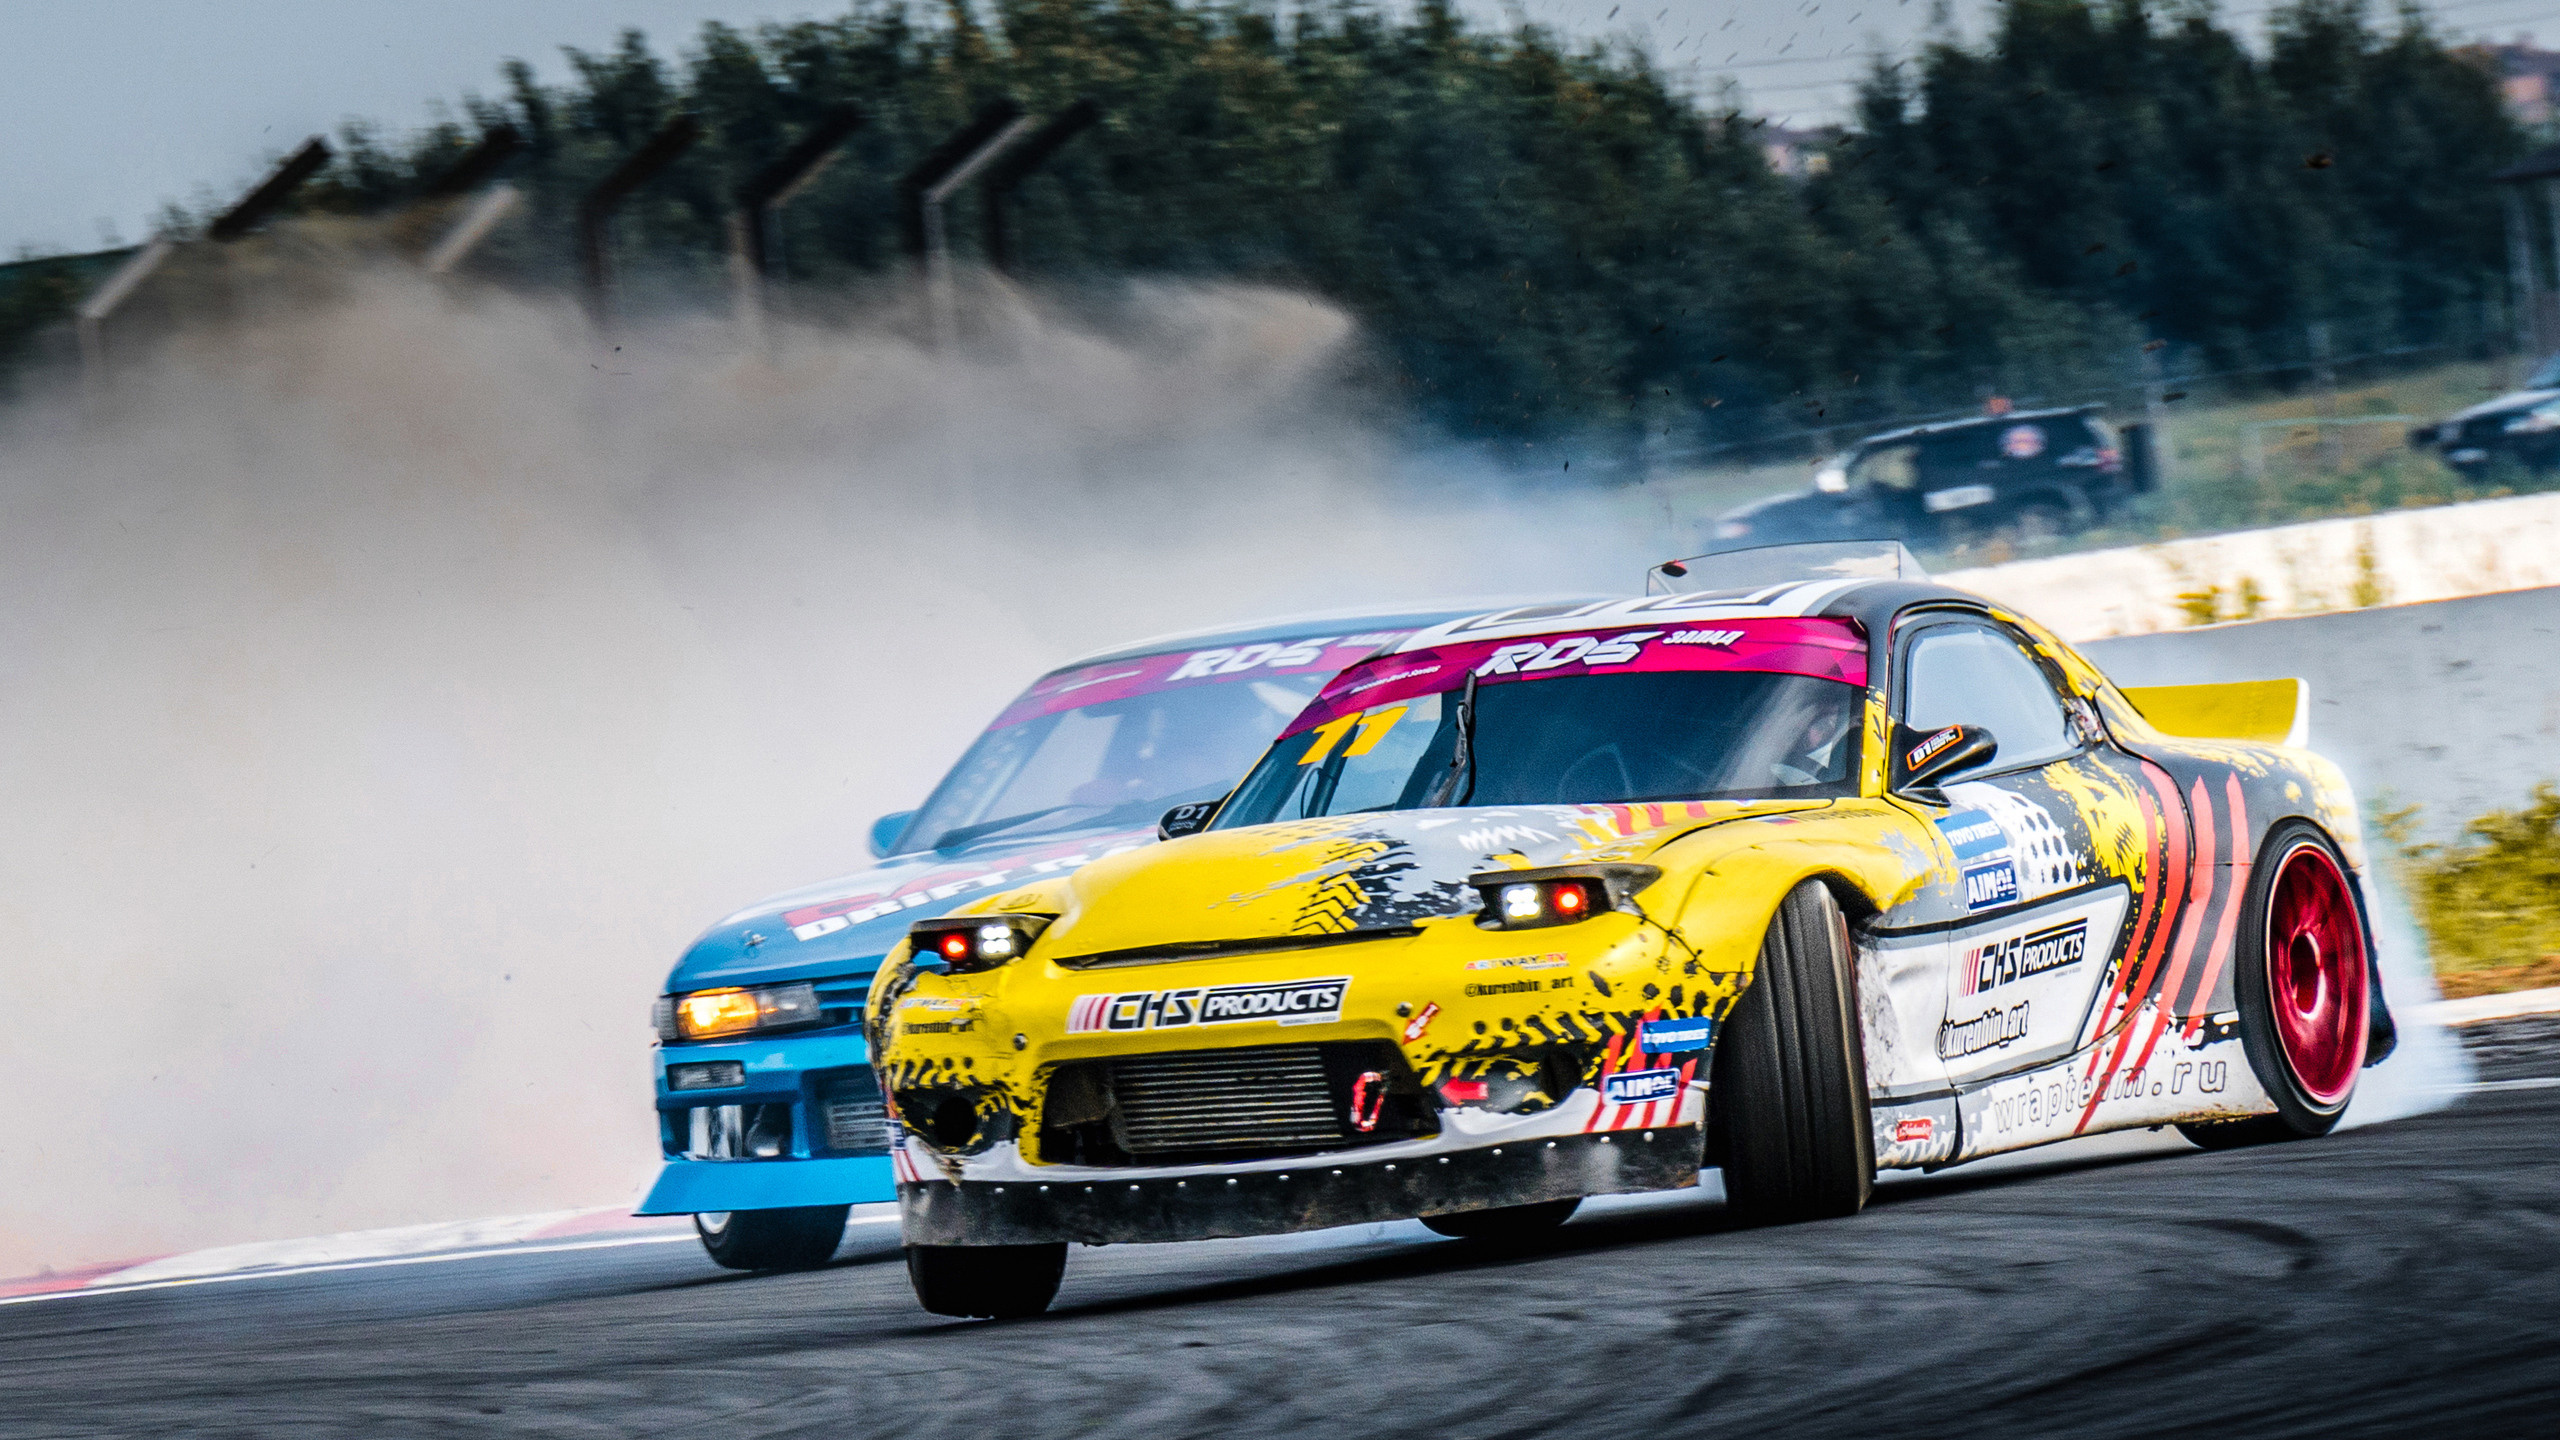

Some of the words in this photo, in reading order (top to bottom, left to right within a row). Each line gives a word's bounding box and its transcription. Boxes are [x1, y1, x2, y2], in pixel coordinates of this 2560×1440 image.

[1166, 636, 1341, 682] RDS
[1476, 631, 1666, 678] RDS
[1297, 705, 1409, 766] 11
[1174, 805, 1211, 820] D1
[1945, 827, 1975, 846] TOYO
[1977, 936, 2022, 993] CHS
[2022, 931, 2085, 975] PRODUCTS
[1108, 990, 1200, 1030] CHS
[1204, 986, 1340, 1018] PRODUCTS
[1993, 1060, 2227, 1133] wrapteam.ru
